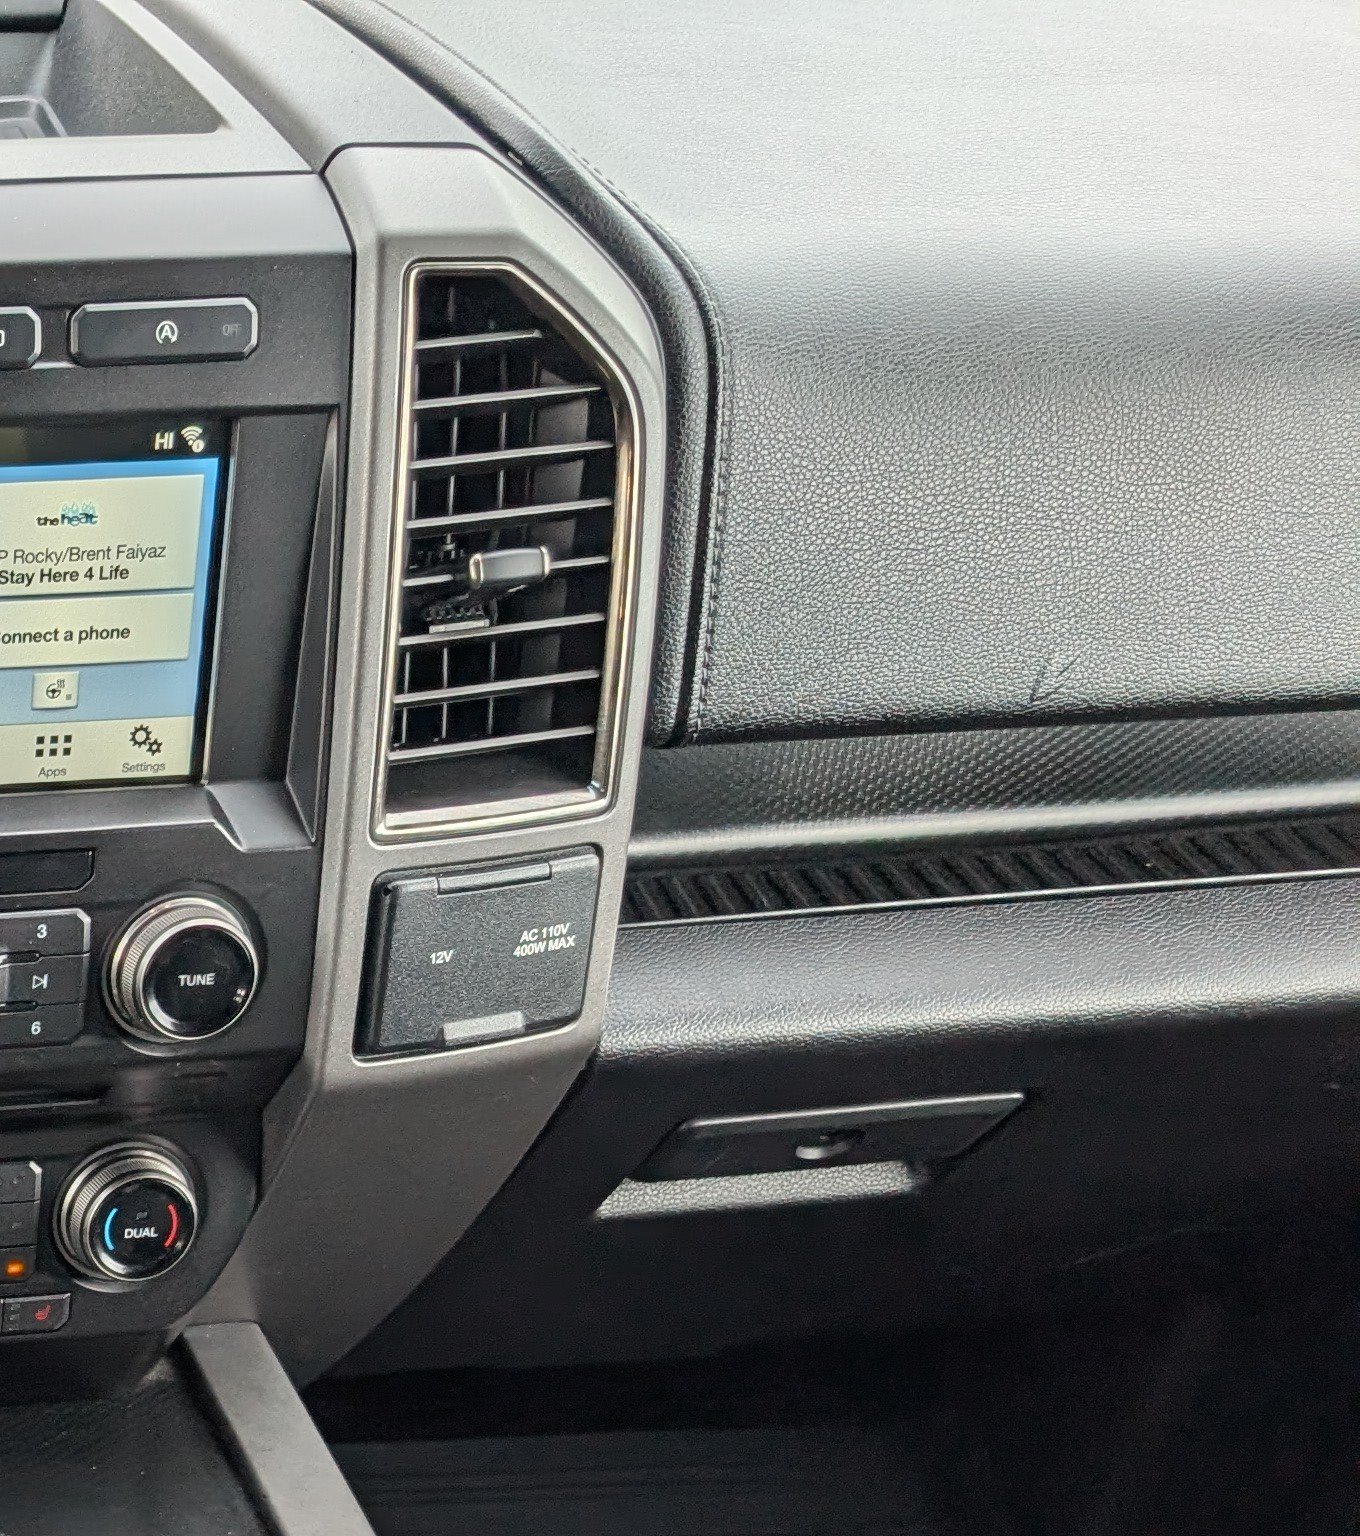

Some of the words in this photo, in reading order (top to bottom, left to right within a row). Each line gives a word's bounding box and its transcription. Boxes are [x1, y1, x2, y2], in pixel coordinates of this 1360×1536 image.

[154, 431, 175, 450] HI
[36, 516, 59, 527] the
[61, 511, 98, 527] heat
[13, 545, 111, 566] Rocky/Brent
[116, 543, 166, 562] Faiyaz
[39, 568, 80, 583] Here
[83, 568, 95, 581] 4
[99, 565, 130, 580] Life
[64, 631, 73, 642] a
[79, 625, 130, 644] phone
[38, 766, 67, 778] Apps
[122, 761, 166, 775] Settings
[37, 924, 47, 938] 3
[519, 928, 539, 943] AC
[541, 923, 570, 939] 110V
[512, 943, 548, 958] 400W
[547, 935, 576, 951] MAX
[430, 950, 454, 964] 12V
[178, 973, 216, 986] TUNE
[31, 1021, 41, 1035] 6
[123, 1227, 159, 1239] DUAL
